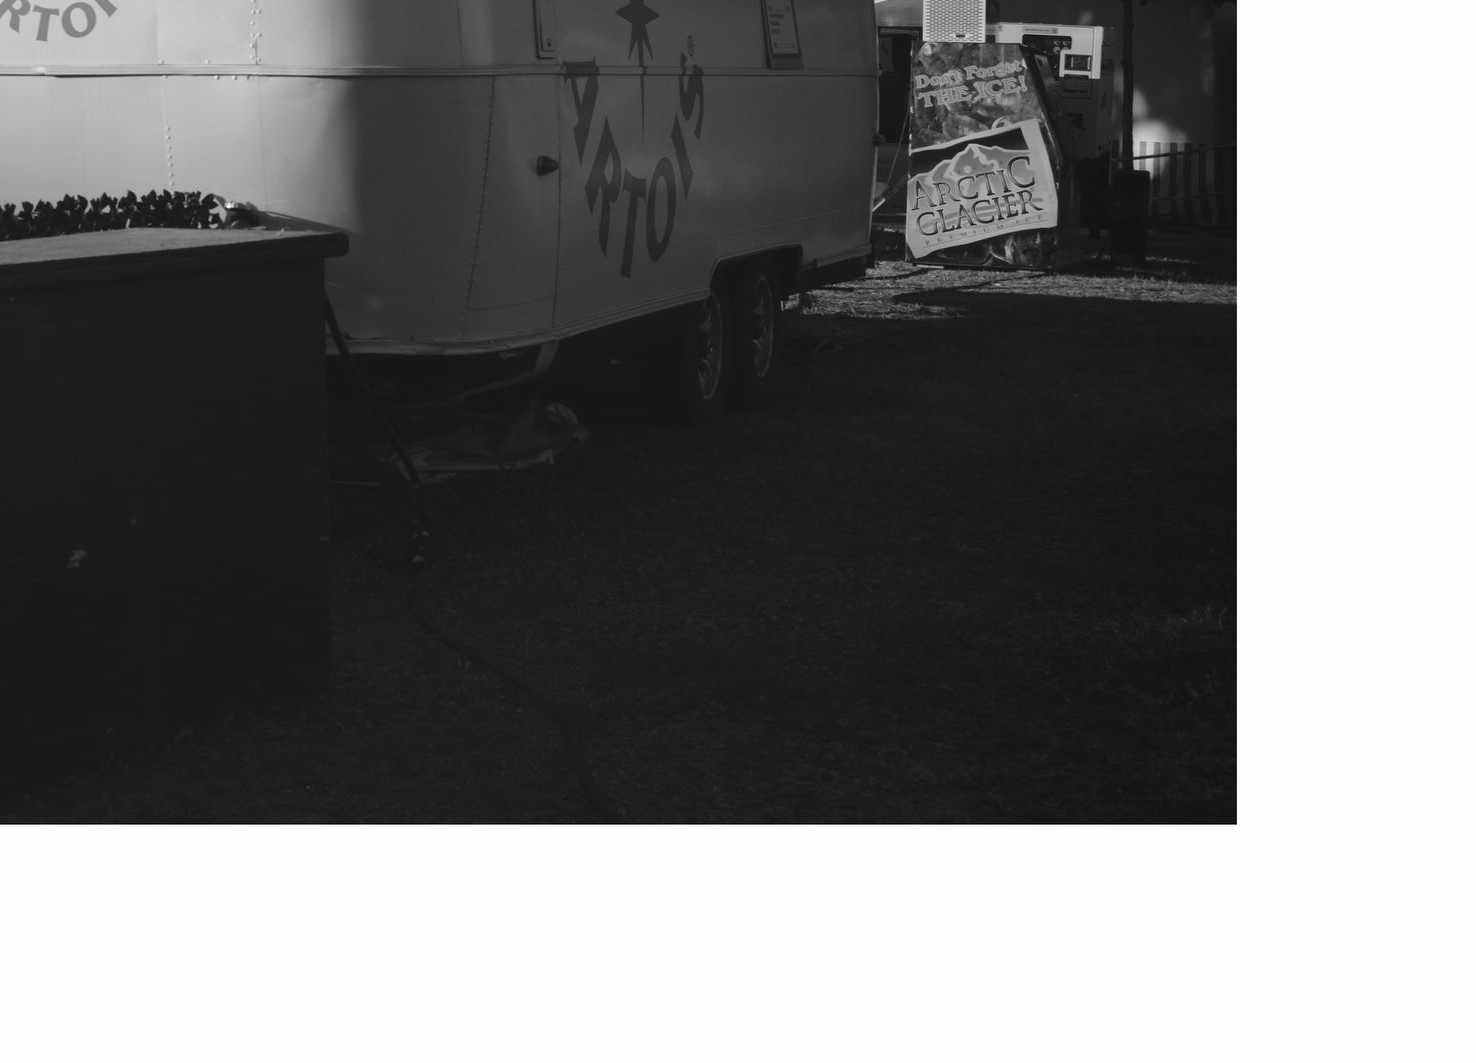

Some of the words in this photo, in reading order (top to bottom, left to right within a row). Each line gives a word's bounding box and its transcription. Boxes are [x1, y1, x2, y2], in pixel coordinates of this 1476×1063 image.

[915, 69, 963, 90] Don't
[964, 60, 1024, 81] Forget
[917, 85, 973, 108] THE
[970, 75, 1028, 104] ICE!
[563, 52, 705, 279] ARTOIS
[911, 156, 1035, 211] ARCTIC
[916, 189, 1043, 236] GLACIER
[925, 224, 1004, 246] PREMIUM
[1015, 214, 1044, 226] ICE
